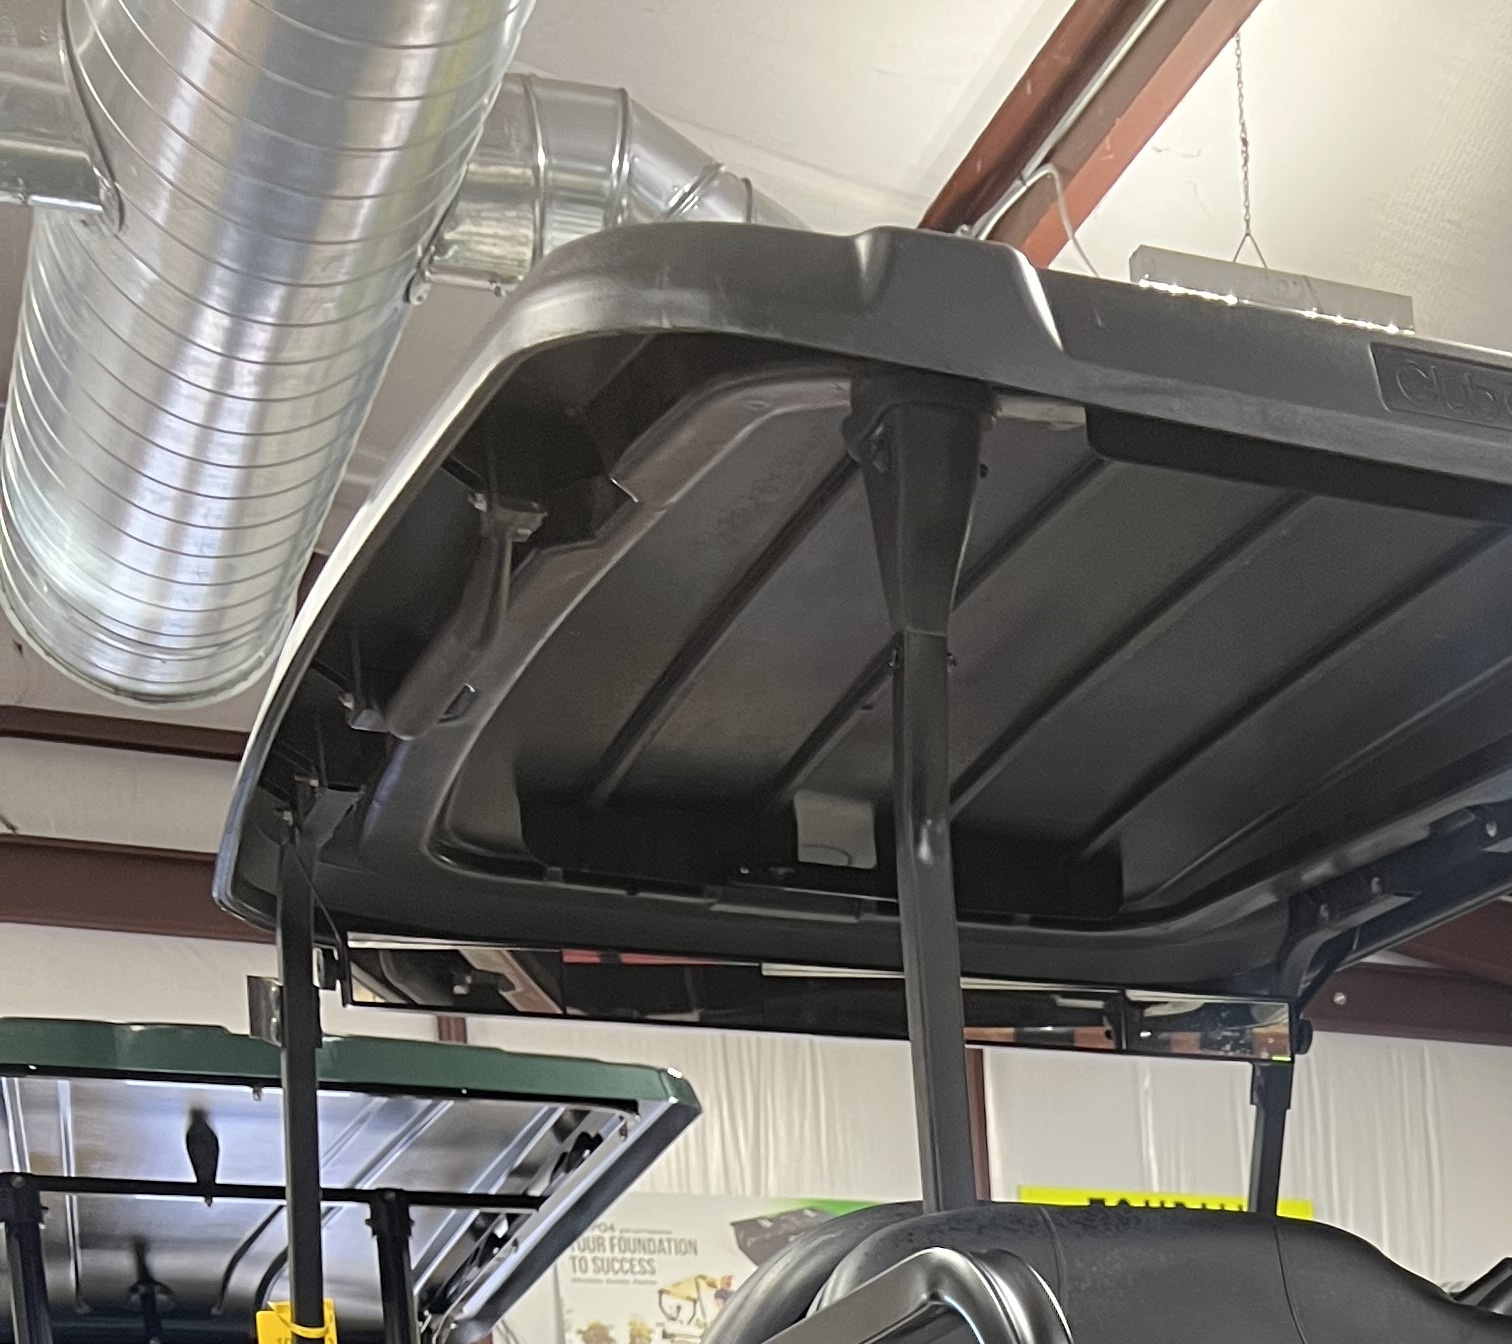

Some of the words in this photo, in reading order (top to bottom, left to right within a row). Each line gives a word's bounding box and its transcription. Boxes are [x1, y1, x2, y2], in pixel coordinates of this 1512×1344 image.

[609, 1235, 698, 1257] FOUNDATION
[570, 1255, 589, 1274] TO
[591, 1256, 657, 1276] SUCCESS
